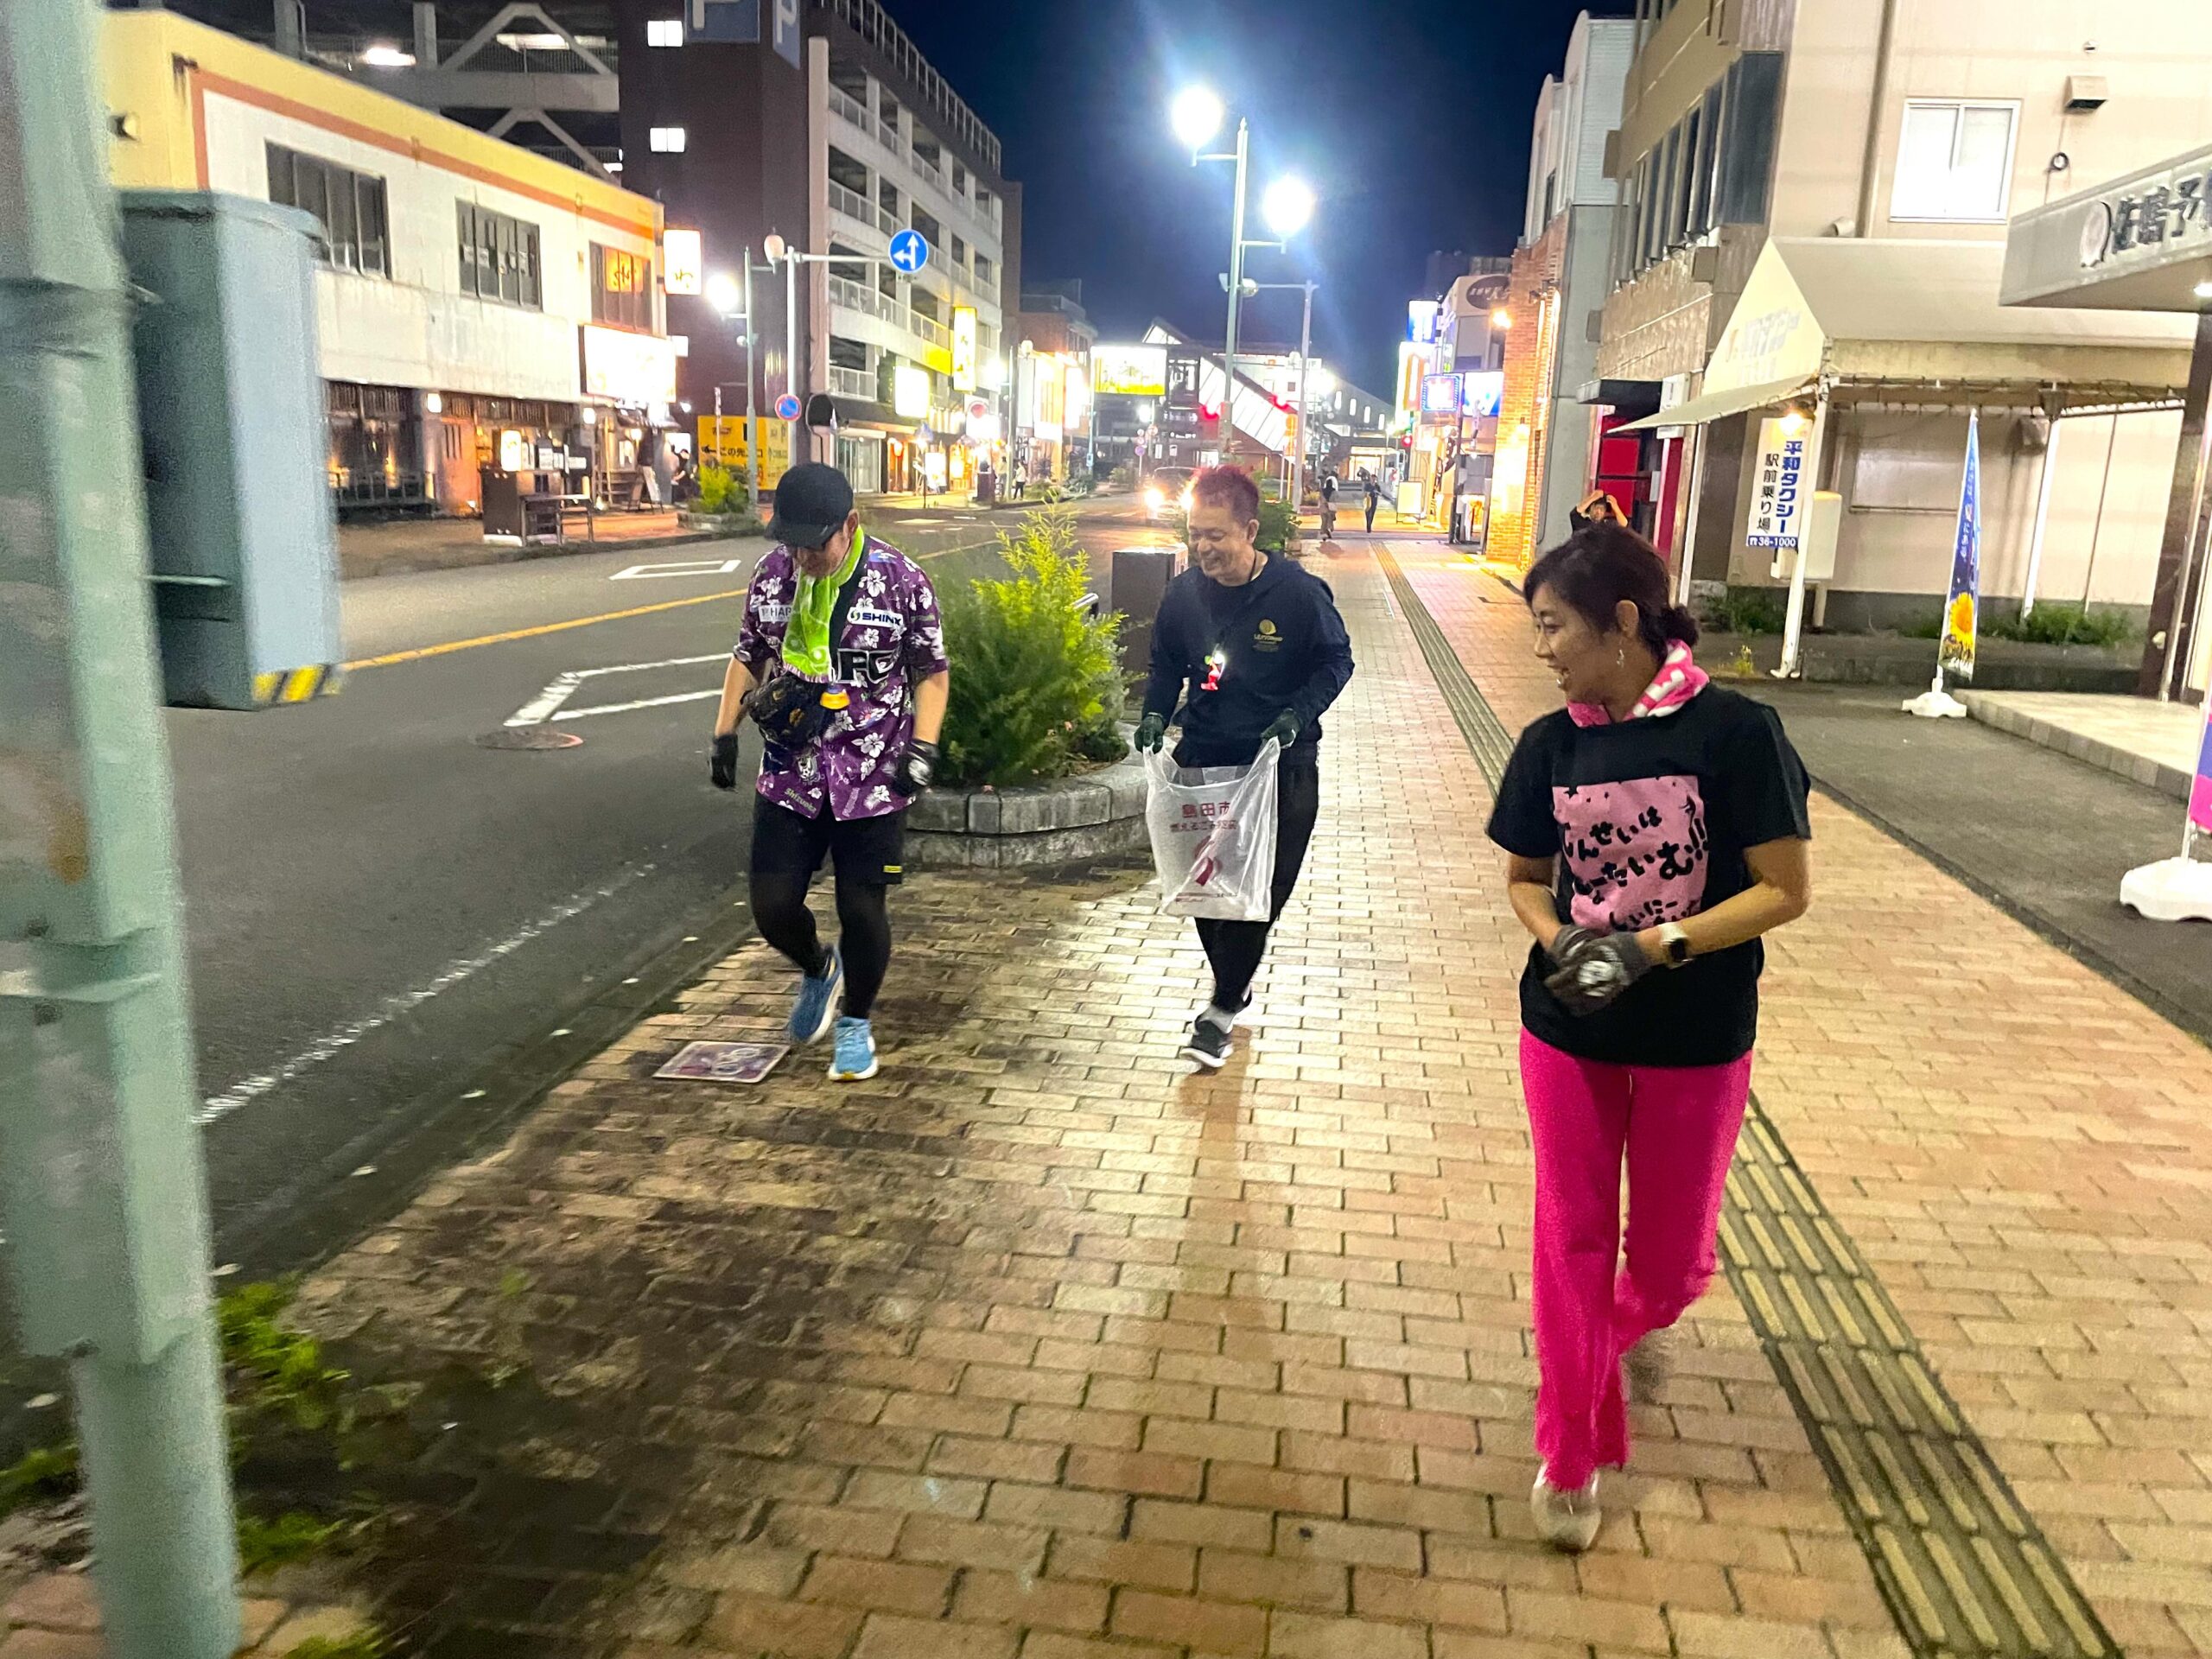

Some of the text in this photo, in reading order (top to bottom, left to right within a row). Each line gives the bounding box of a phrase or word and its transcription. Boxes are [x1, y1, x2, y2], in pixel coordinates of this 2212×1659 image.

[2112, 169, 2212, 254] 佐鳴予
[720, 447, 763, 458] この先口
[1757, 454, 1779, 533] 駅前乗り場
[1776, 441, 1802, 533] 平和タクシー
[1759, 537, 1796, 547] 36-1000
[861, 611, 902, 626] SHINX
[1181, 801, 1230, 818] 島田市
